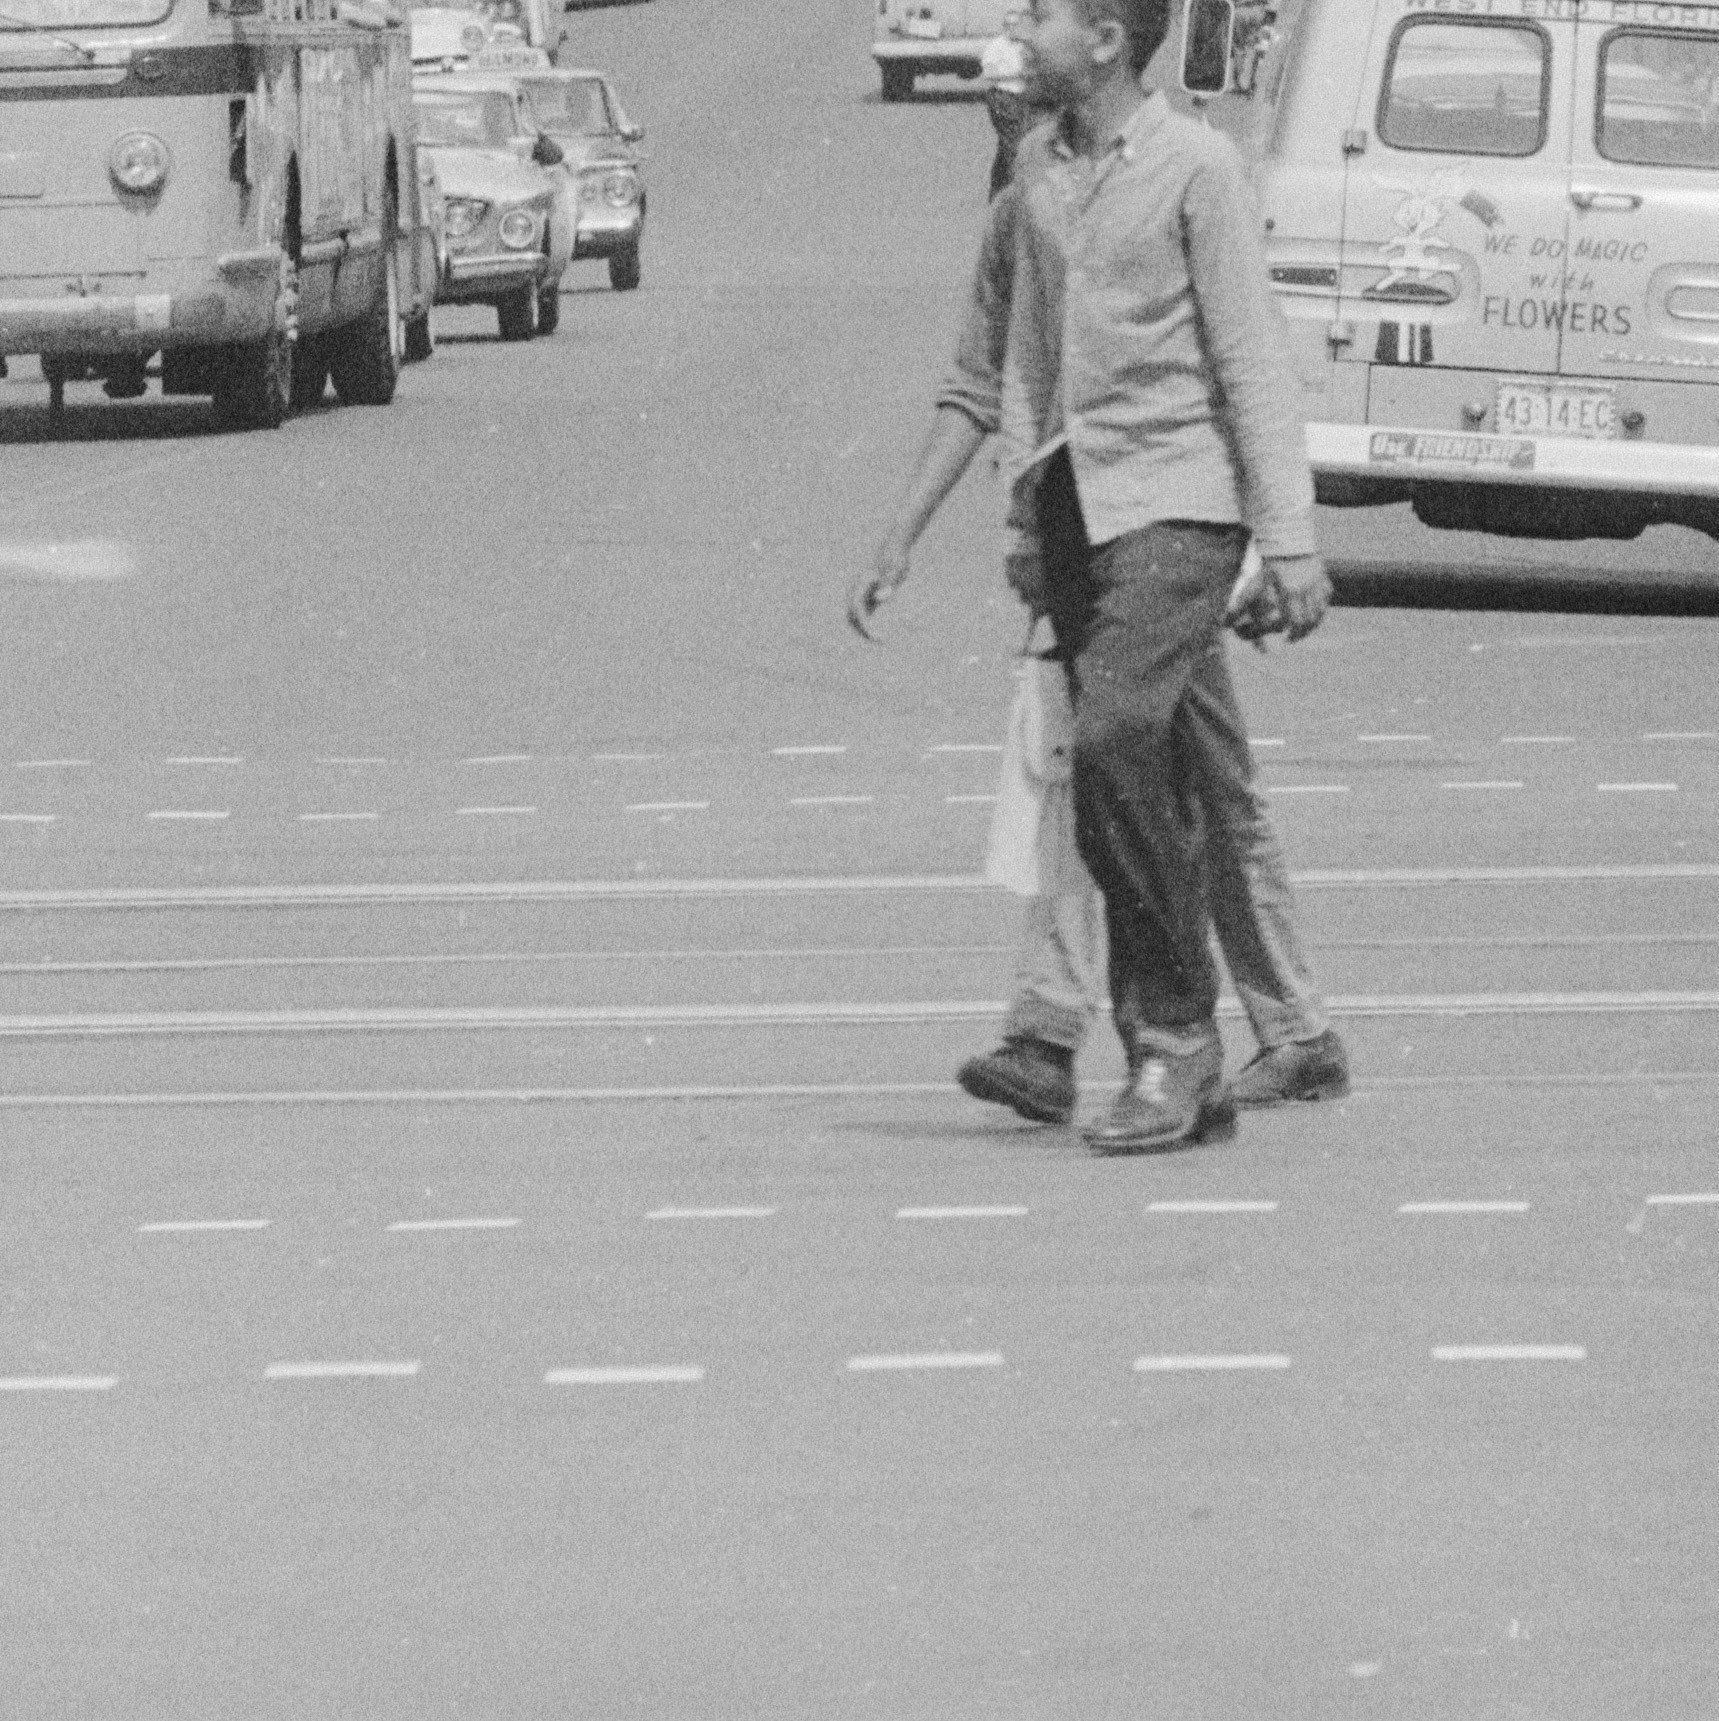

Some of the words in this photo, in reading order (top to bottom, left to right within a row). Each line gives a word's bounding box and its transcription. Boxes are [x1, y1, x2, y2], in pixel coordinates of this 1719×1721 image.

[1483, 233, 1518, 256] WE
[1530, 237, 1566, 258] DO
[1574, 238, 1650, 263] MAGIC
[1529, 271, 1595, 291] with
[1482, 295, 1632, 336] FLOWERS
